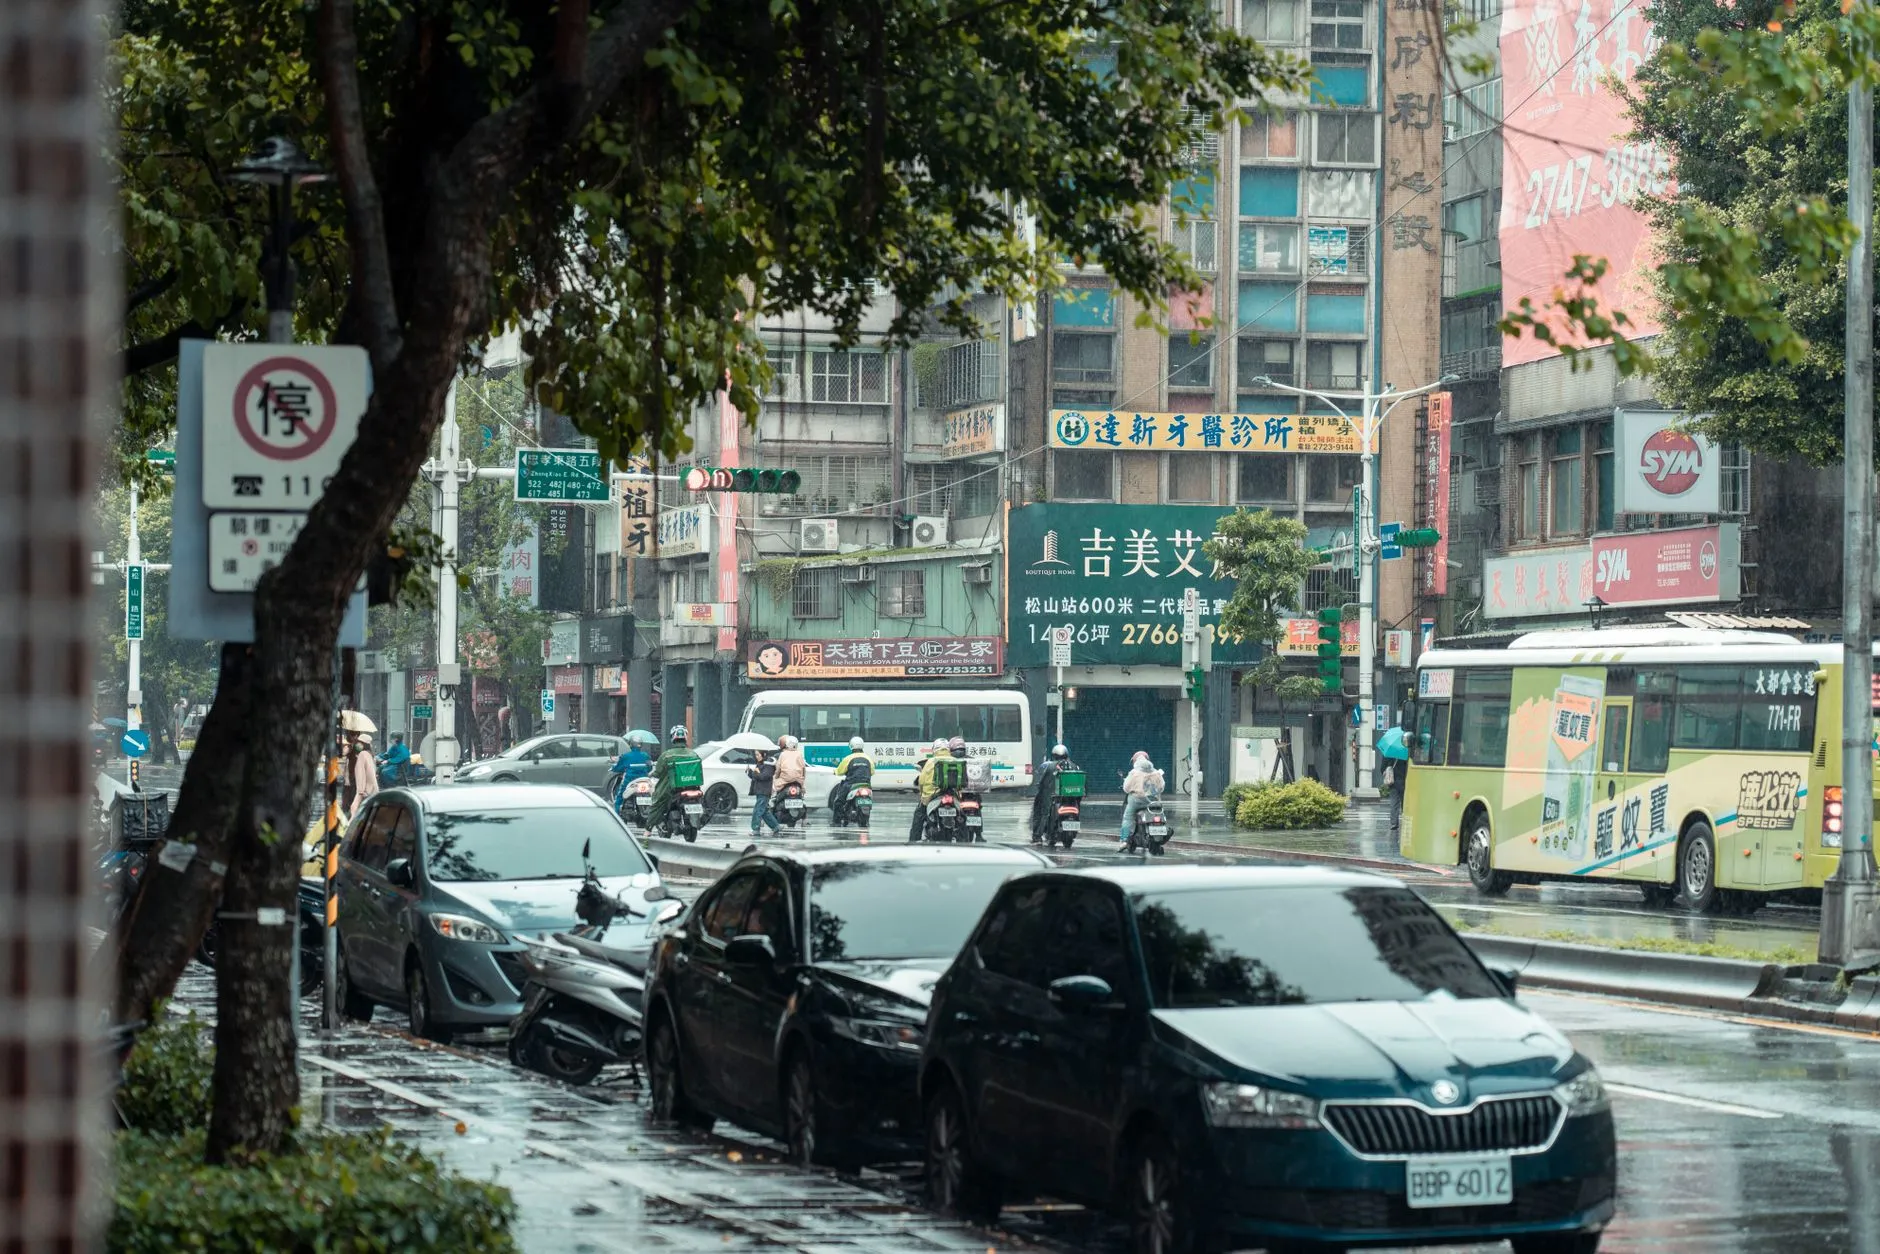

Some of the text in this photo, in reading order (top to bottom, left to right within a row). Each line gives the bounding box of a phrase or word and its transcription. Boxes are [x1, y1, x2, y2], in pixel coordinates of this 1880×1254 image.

[257, 381, 312, 437] 停
[1093, 412, 1293, 449] 達新牙醫診所
[1312, 442, 1354, 451] 2723-9144
[1639, 449, 1703, 482] SYM
[282, 475, 332, 497] 11
[575, 490, 591, 499] 473
[622, 487, 652, 554] 植牙
[1596, 548, 1631, 592] SYM
[1025, 597, 1134, 615] 松山站600米
[1755, 669, 1815, 696] 大都會客運
[1768, 704, 1801, 731] 771-FR
[1737, 816, 1778, 829] SPEED
